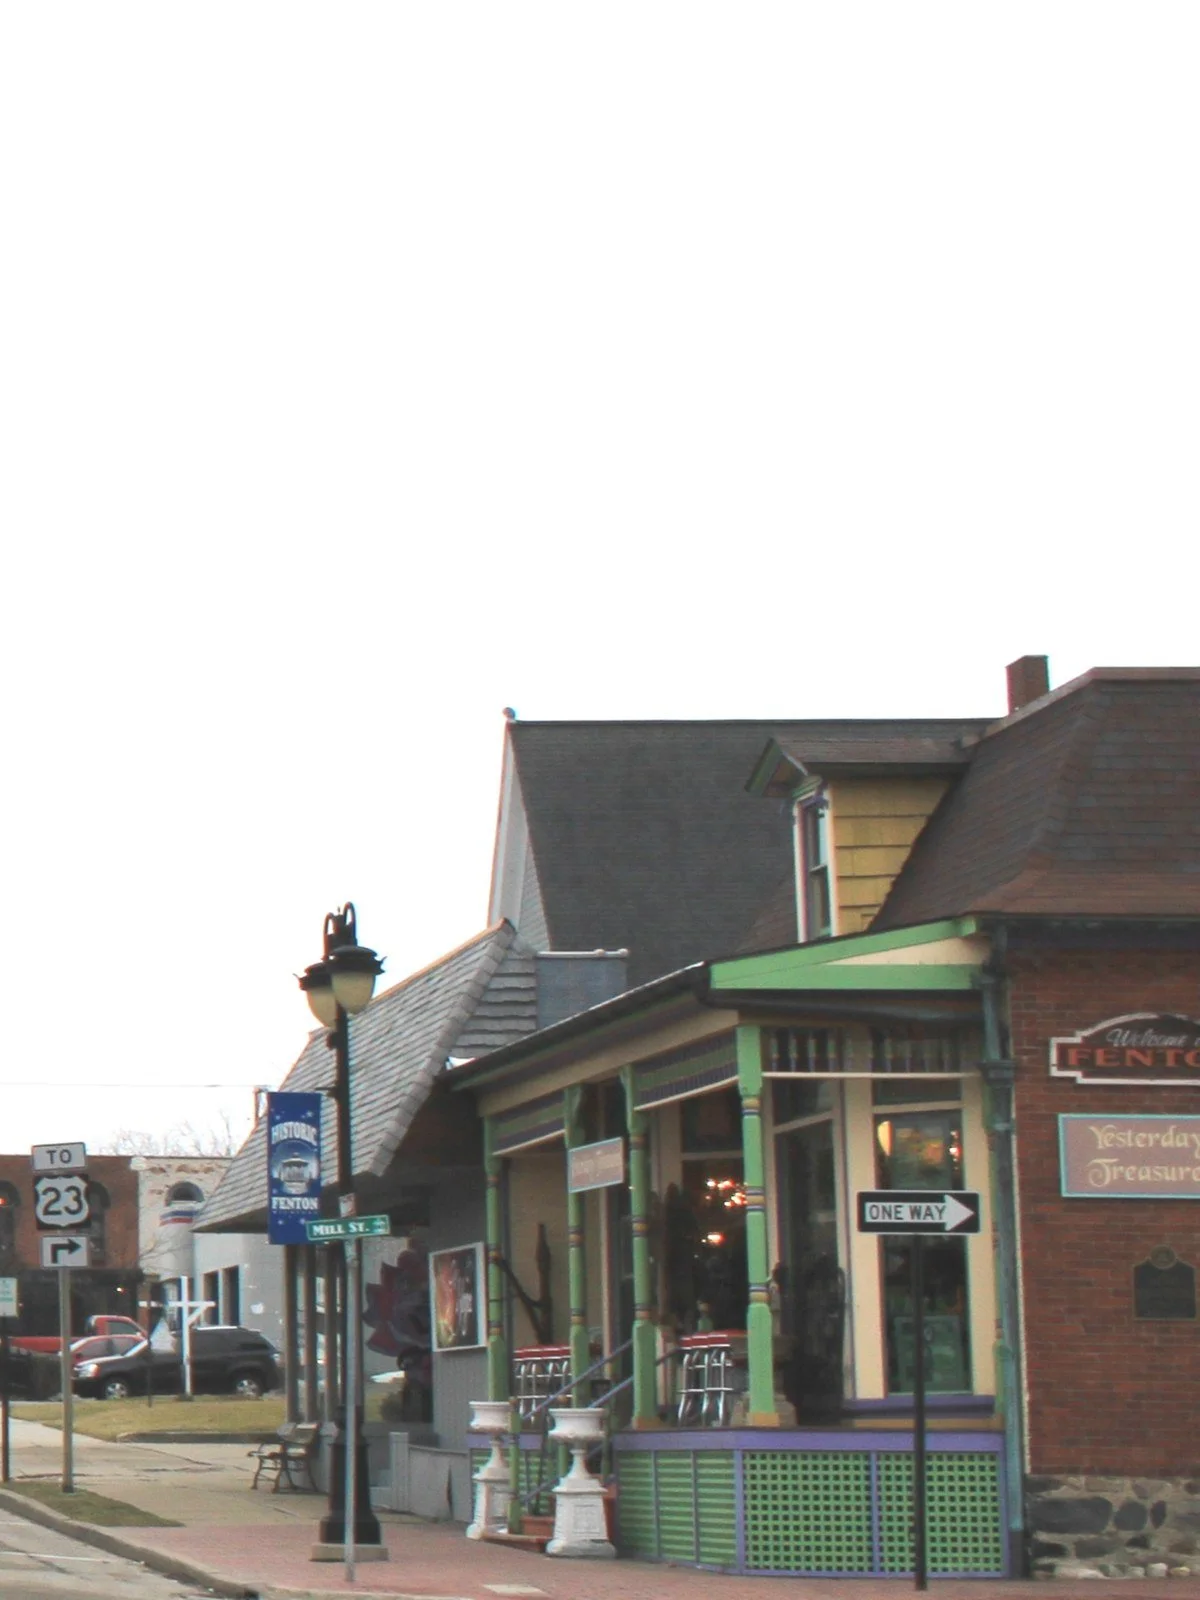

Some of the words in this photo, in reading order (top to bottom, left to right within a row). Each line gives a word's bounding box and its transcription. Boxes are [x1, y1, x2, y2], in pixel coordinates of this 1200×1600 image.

[1106, 1028, 1188, 1048] Welcome
[271, 1121, 318, 1146] HISTORIC
[46, 1149, 72, 1164] TO
[42, 1186, 83, 1215] 23
[271, 1197, 318, 1210] FENTON
[869, 1204, 904, 1220] ONE
[909, 1204, 946, 1220] WAY
[312, 1224, 345, 1236] MILL
